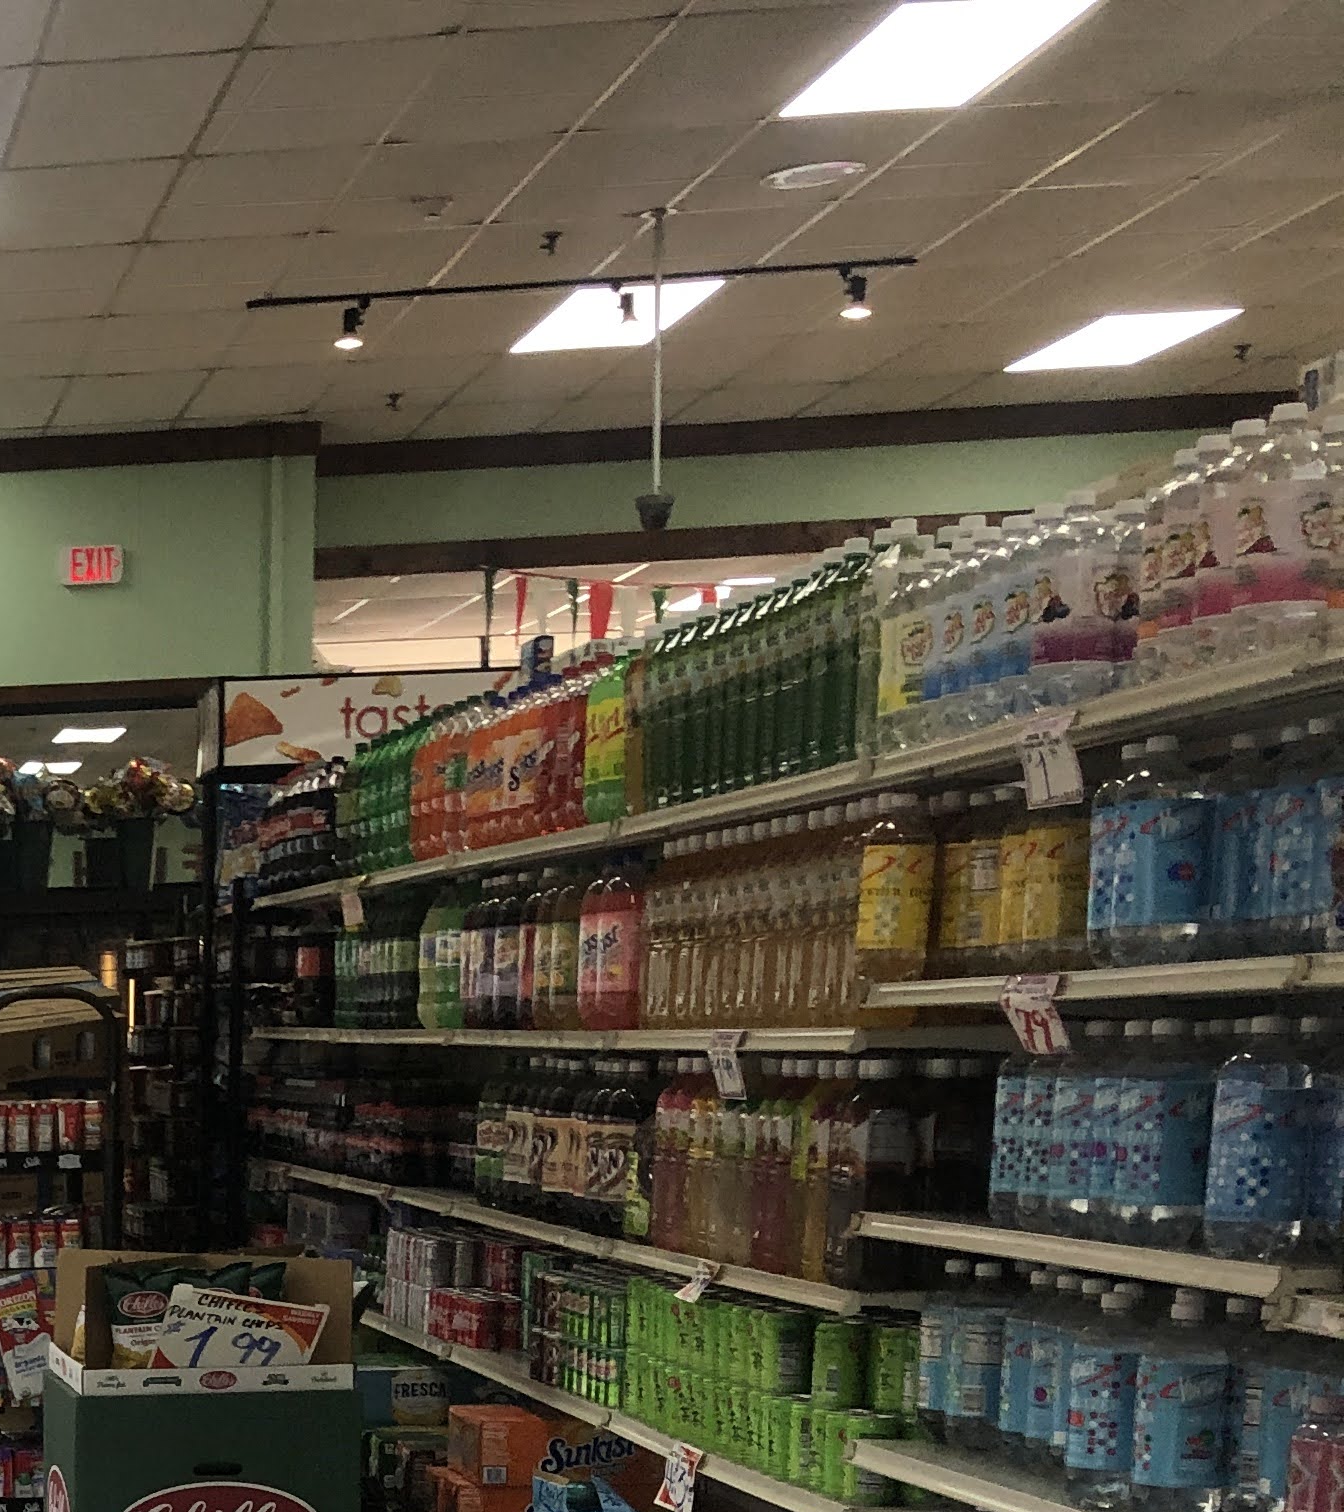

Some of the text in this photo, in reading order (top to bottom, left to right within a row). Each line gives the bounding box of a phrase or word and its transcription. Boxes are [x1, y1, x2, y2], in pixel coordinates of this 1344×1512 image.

[71, 547, 115, 583] EXIT
[169, 1304, 238, 1326] PLANTAIN
[231, 1332, 282, 1366] 99
[394, 1382, 448, 1399] FRESCA
